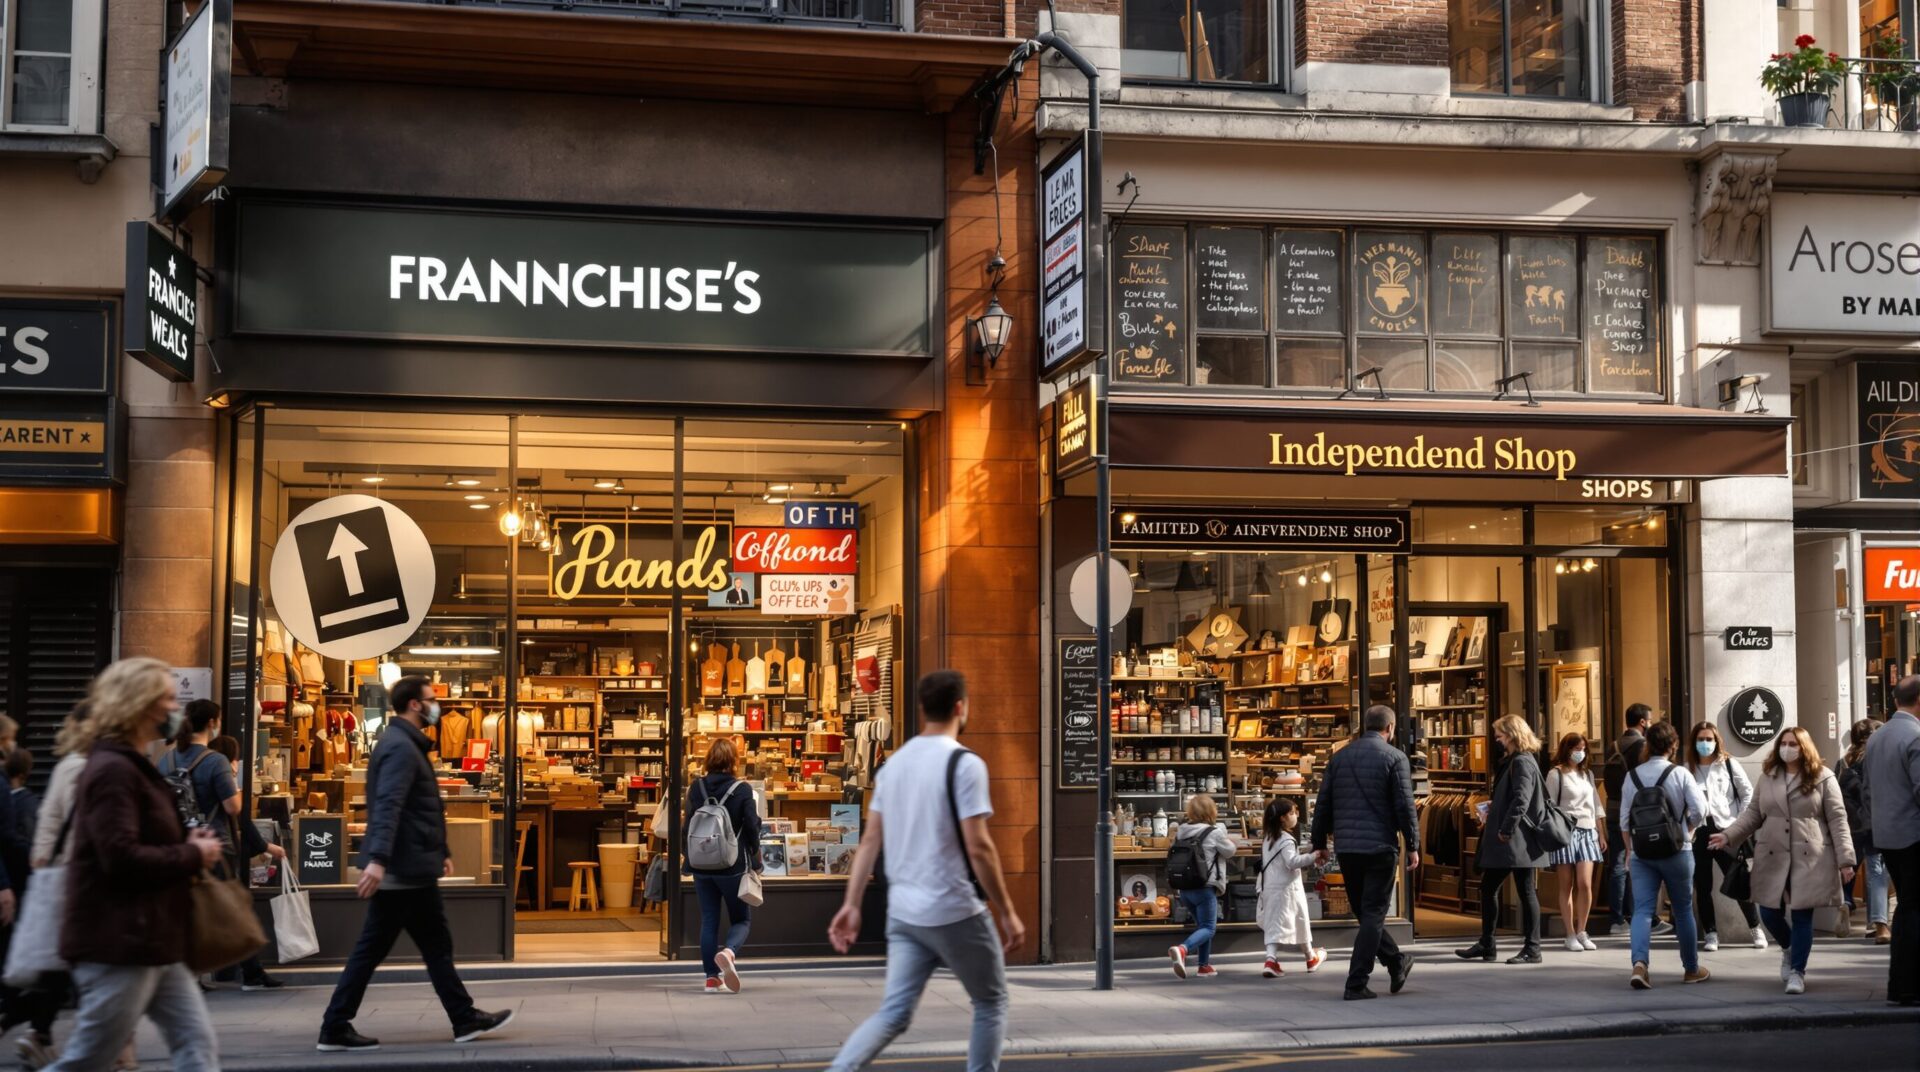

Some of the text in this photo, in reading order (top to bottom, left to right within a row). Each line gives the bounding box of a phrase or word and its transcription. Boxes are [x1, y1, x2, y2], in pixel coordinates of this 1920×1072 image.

[389, 254, 761, 314] FRANNCHISE'S
[1842, 296, 1920, 316] BY MA
[0, 326, 50, 375] S
[0, 426, 74, 444] ARENT
[1269, 431, 1576, 481] Independend Shop
[1582, 479, 1653, 498] SHOPS
[1353, 526, 1393, 538] SHOP
[1884, 559, 1920, 590] Fu
[803, 580, 823, 593] UPS
